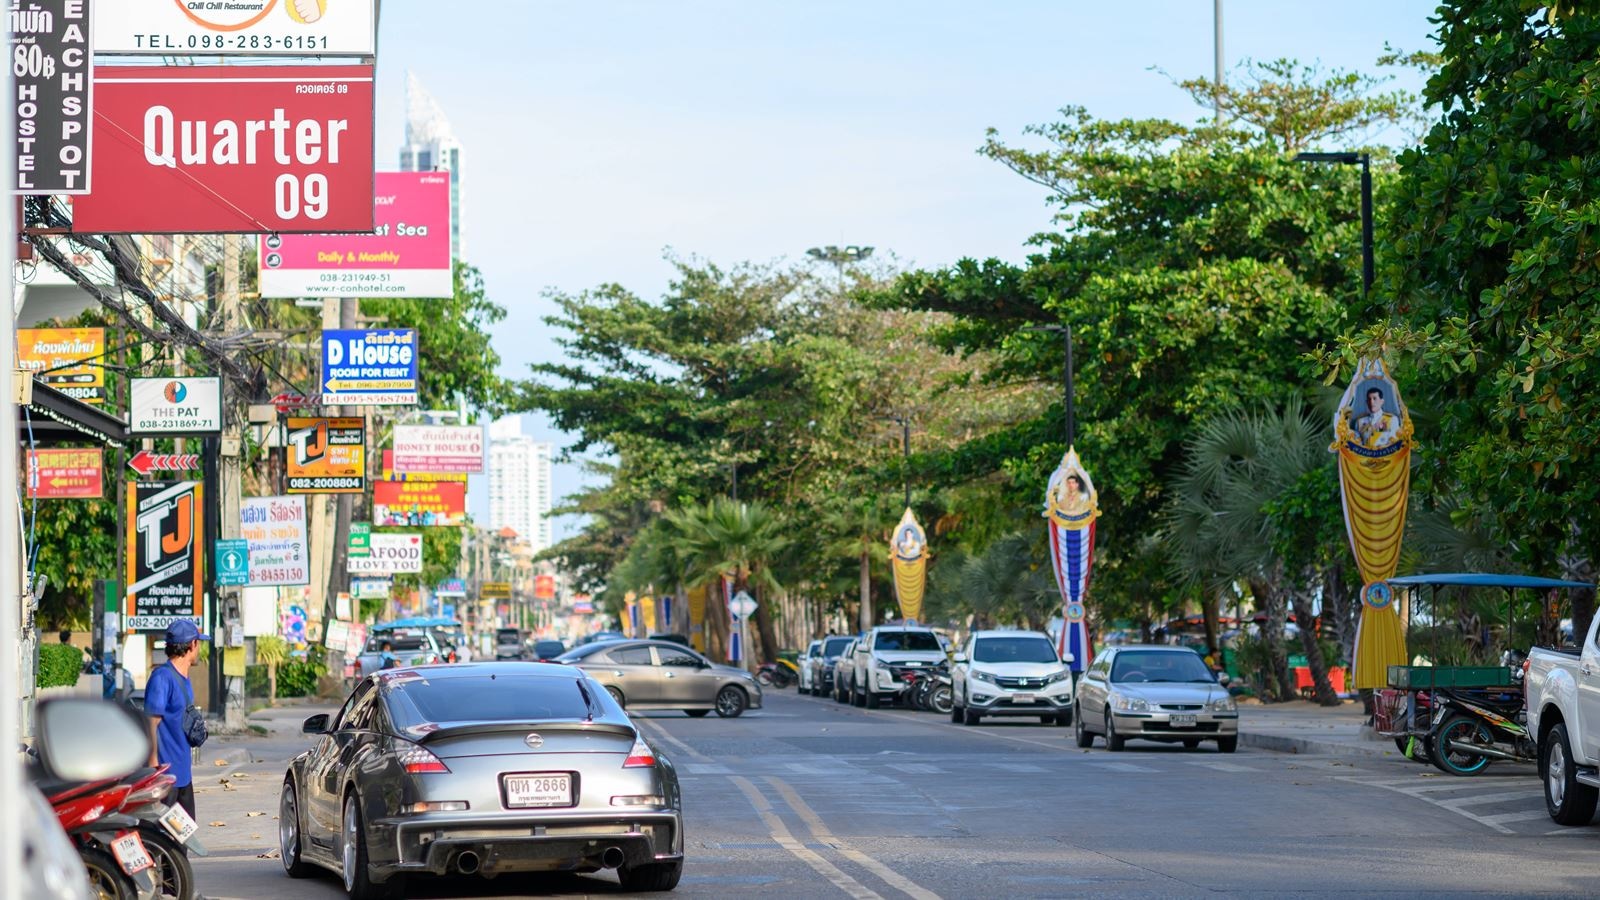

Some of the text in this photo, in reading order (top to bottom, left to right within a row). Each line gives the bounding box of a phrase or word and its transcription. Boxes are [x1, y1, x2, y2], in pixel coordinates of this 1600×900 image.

[224, 2, 264, 10] Restaurant
[337, 84, 348, 94] 09
[18, 85, 38, 189] HOSTEL
[144, 105, 348, 168] Quarter
[275, 173, 329, 220] 09
[396, 222, 428, 236] Sea
[317, 251, 400, 264] Daily & Monthly
[320, 274, 391, 282] 038-231949-51
[306, 284, 406, 292] www.r-conhotel.com
[33, 338, 96, 354] ห้องพักใหม่
[327, 339, 413, 365] D House
[329, 368, 410, 378] ROOM FOR RENT
[152, 407, 200, 417] THE PAT
[140, 419, 213, 428] 038-231869-71
[289, 424, 326, 465] TJ
[397, 443, 430, 452] HONEY
[435, 443, 468, 452] HOUSE
[290, 478, 360, 488] 082-2008804
[270, 501, 302, 521] รีสอร์ท
[139, 495, 192, 565] TJ
[163, 560, 187, 577] RESORT
[356, 561, 387, 569] LOVE
[393, 561, 419, 569] YOU
[149, 584, 193, 596] ห้องพักใหม่
[138, 597, 158, 606] ราคา
[160, 596, 182, 606] พิเศษ
[534, 779, 567, 793] 2666
